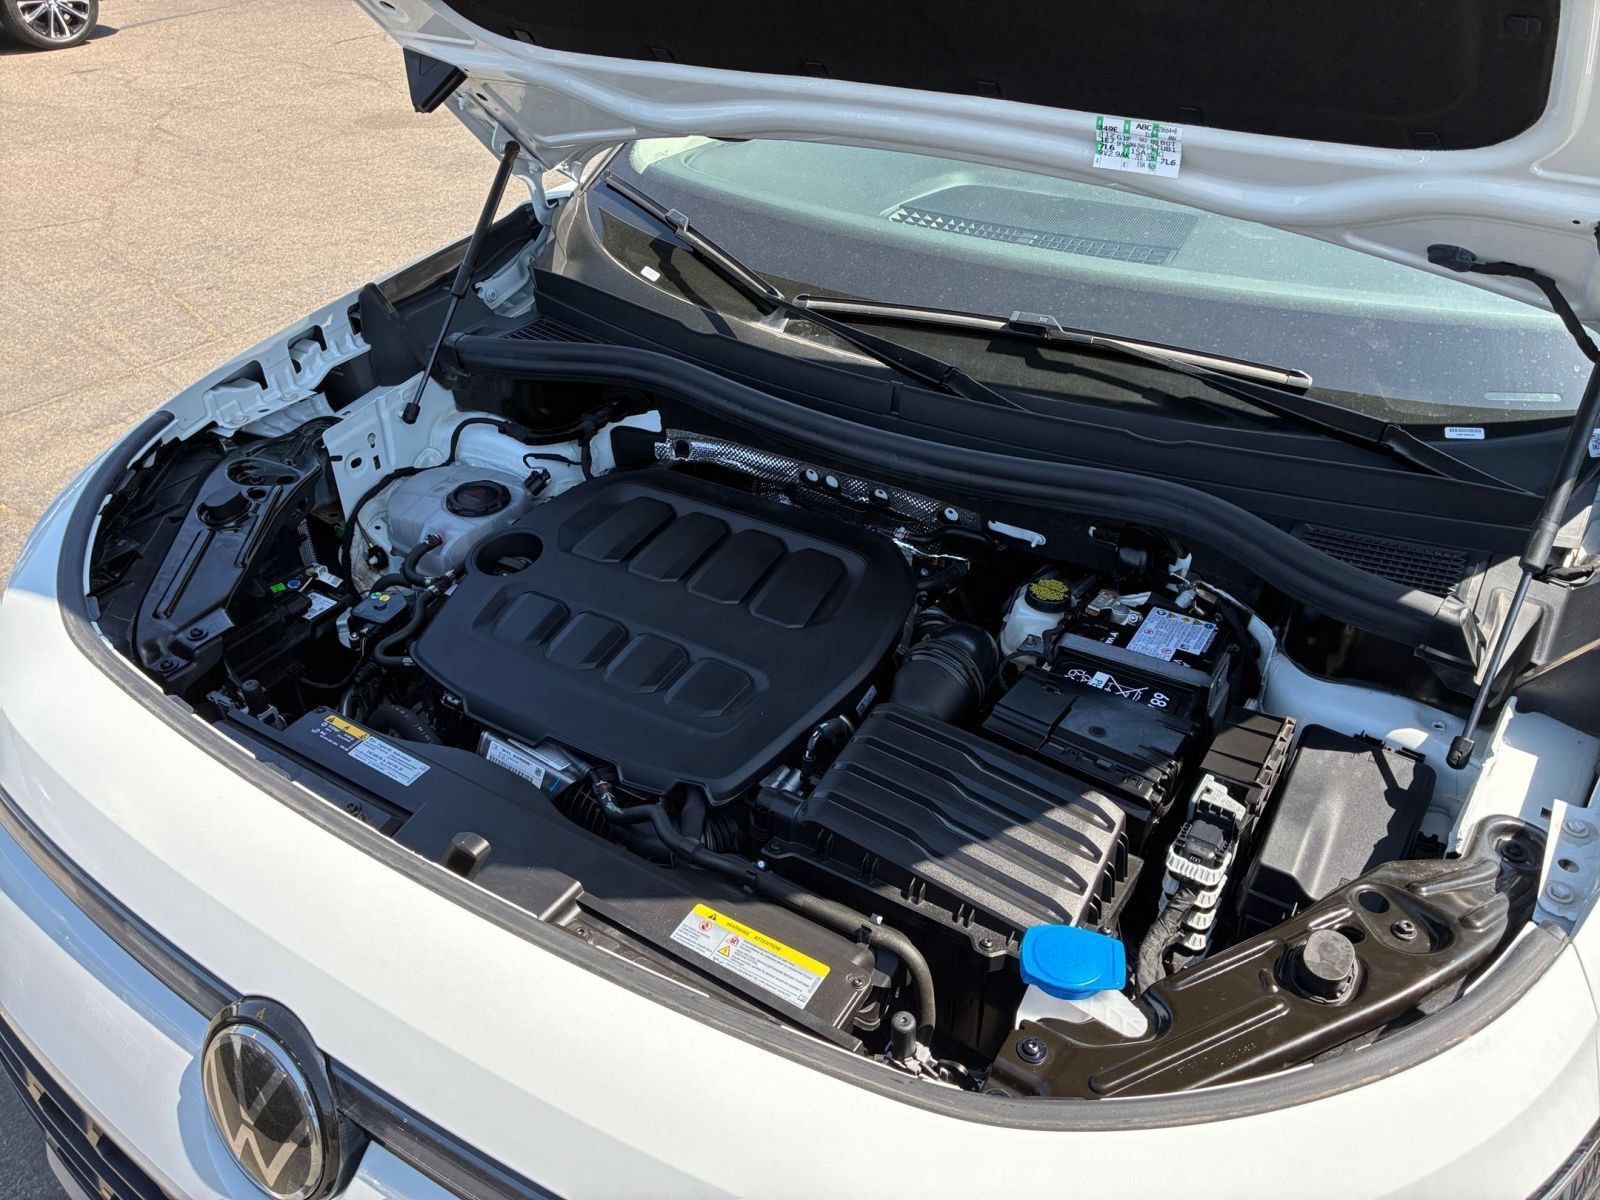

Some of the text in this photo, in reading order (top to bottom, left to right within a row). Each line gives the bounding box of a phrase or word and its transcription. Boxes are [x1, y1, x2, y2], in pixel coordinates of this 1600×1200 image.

[1136, 123, 1153, 131] ABC
[1100, 143, 1115, 151] 7L6
[1160, 158, 1176, 166] 7L6
[726, 921, 751, 937] WARNING
[753, 935, 782, 952] ATTENTION
